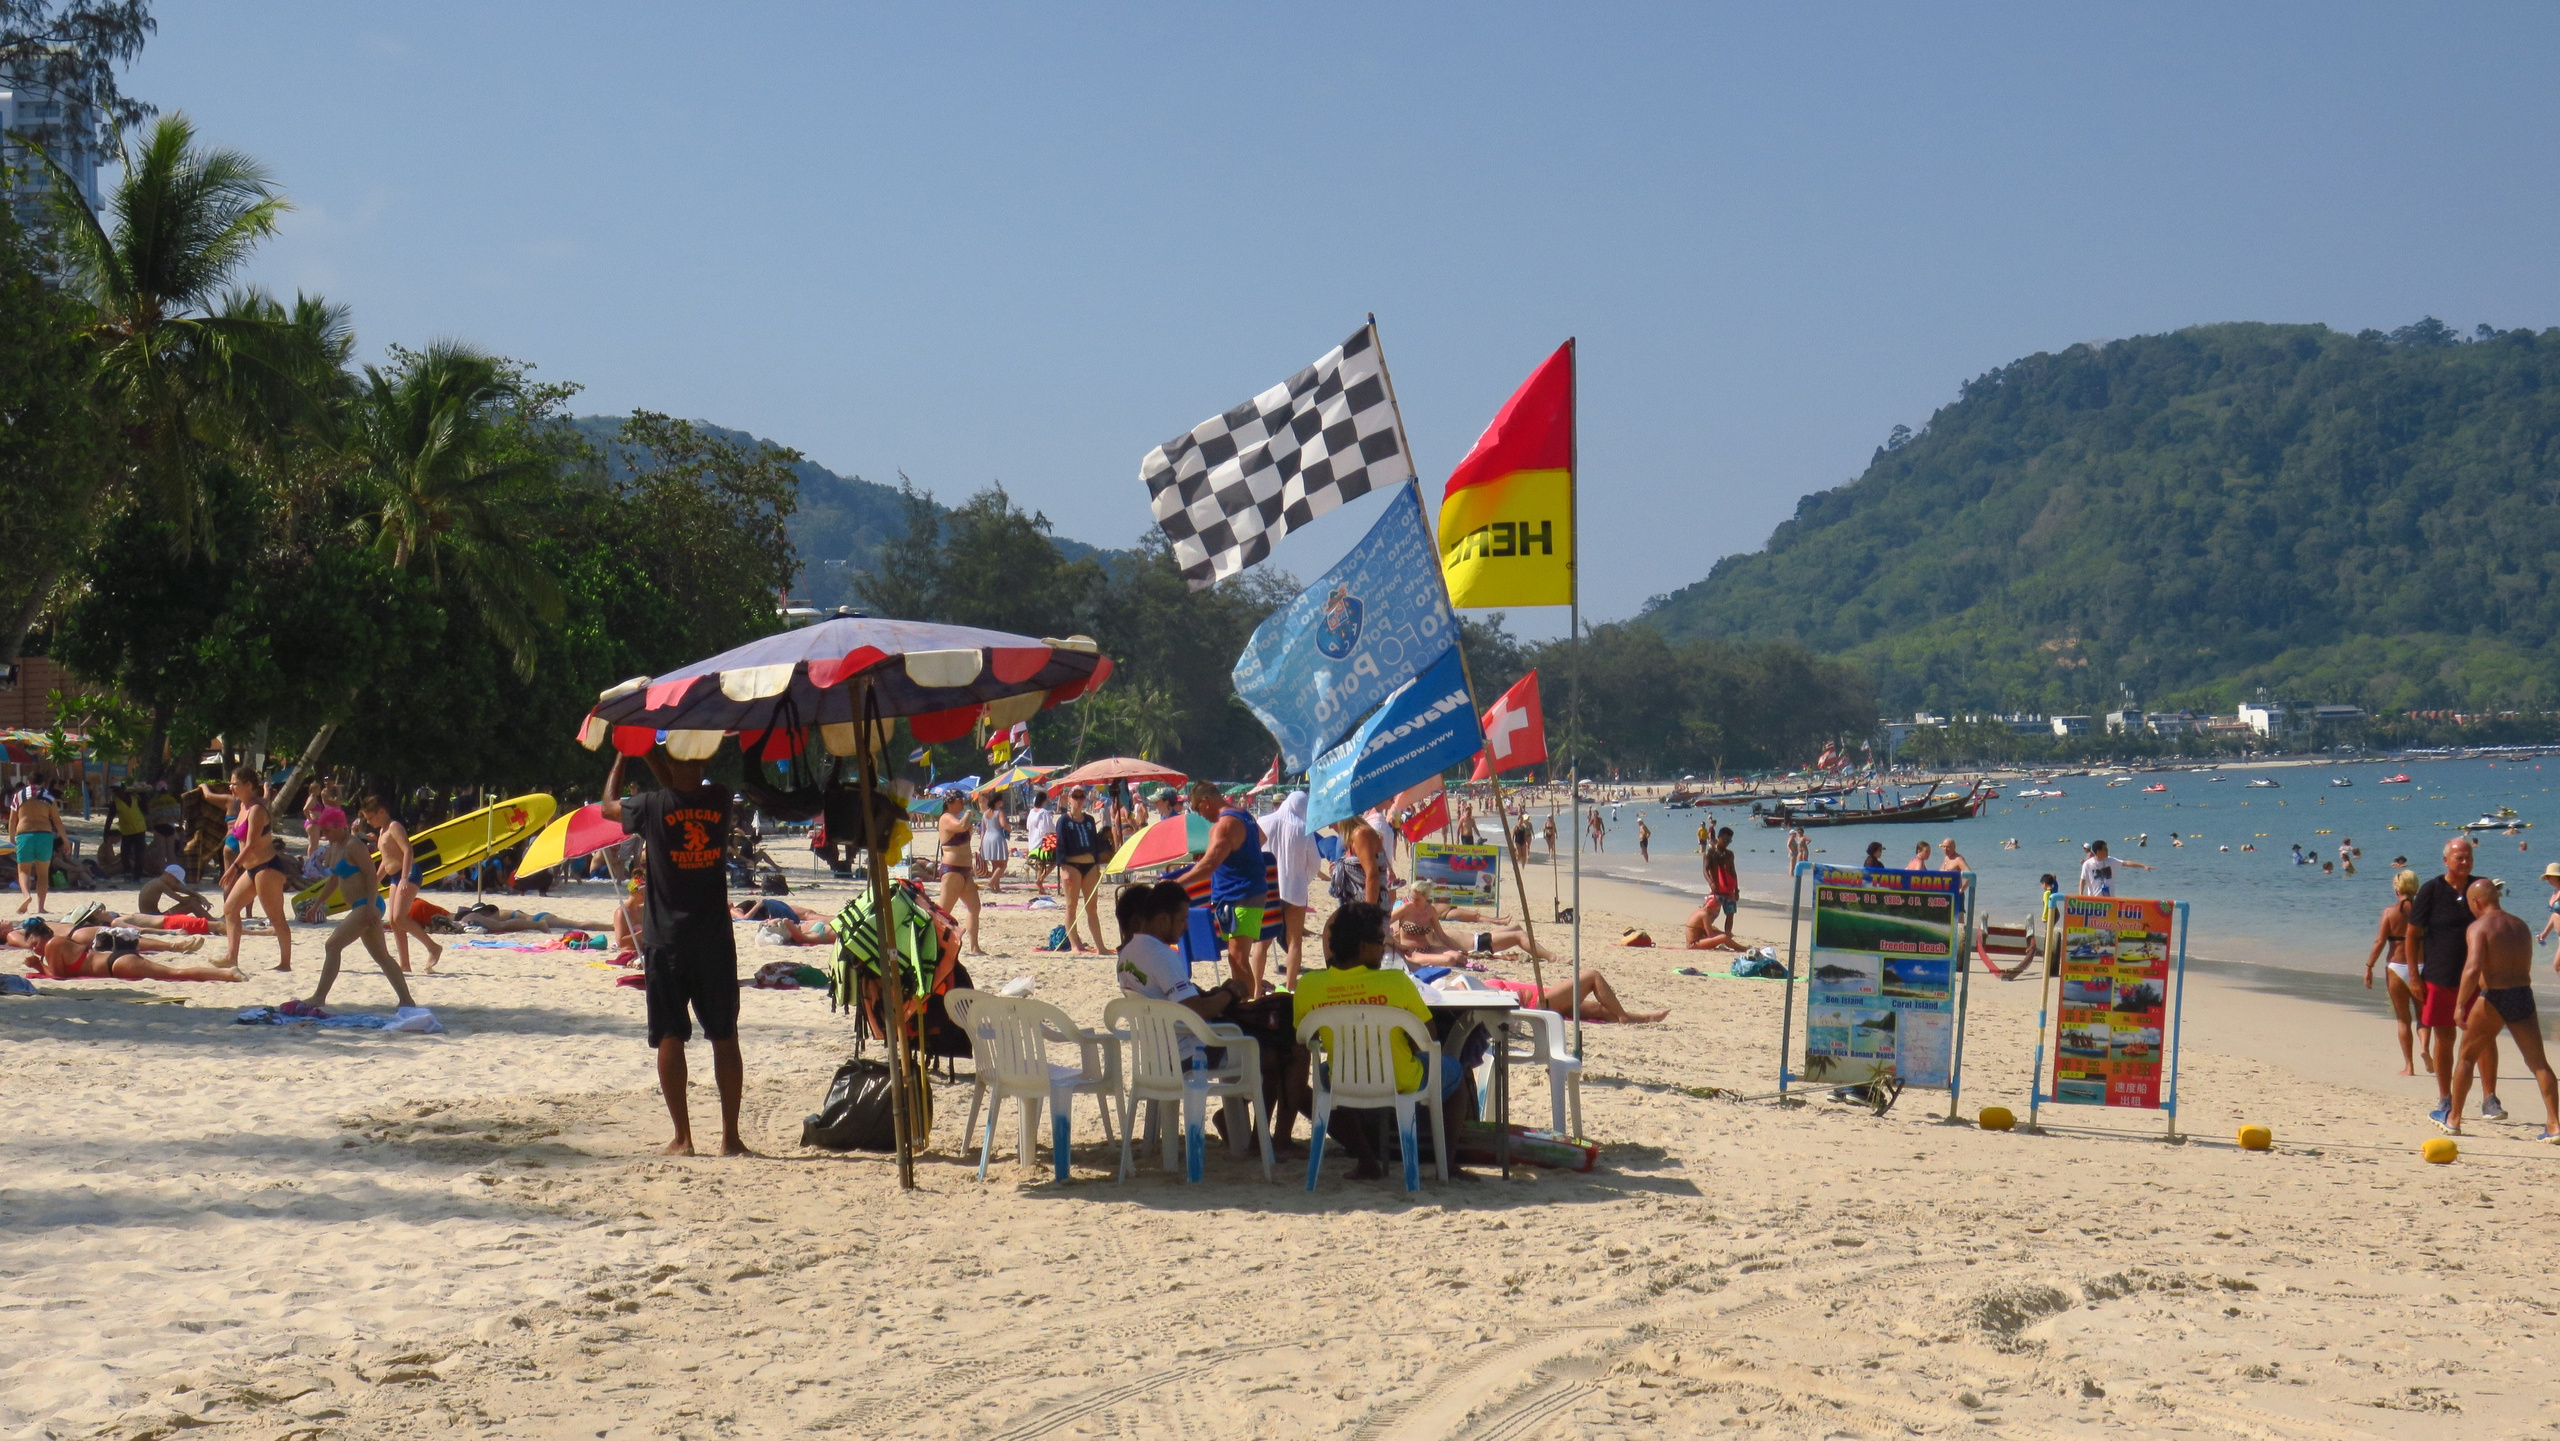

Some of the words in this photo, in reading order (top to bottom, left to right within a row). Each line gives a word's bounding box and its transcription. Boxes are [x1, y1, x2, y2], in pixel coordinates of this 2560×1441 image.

[664, 808, 722, 827] DUNCAN
[669, 847, 721, 863] TAVERN
[1822, 870, 1864, 886] LONG
[1870, 873, 1903, 889] TAIL
[1910, 876, 1952, 891] BOAT
[2067, 897, 2112, 928] Super
[1880, 940, 1917, 952] Freedom
[1919, 942, 1946, 954] Beach
[1826, 995, 1839, 1004] Bon
[1841, 996, 1864, 1005] Island
[1892, 1000, 1912, 1009] Coral
[1915, 1001, 1939, 1010] Island
[1833, 1048, 1848, 1057] Rock
[1850, 1051, 1873, 1059] Banana
[1875, 1051, 1896, 1060] Beach
[2120, 1096, 2141, 1107] 出租
